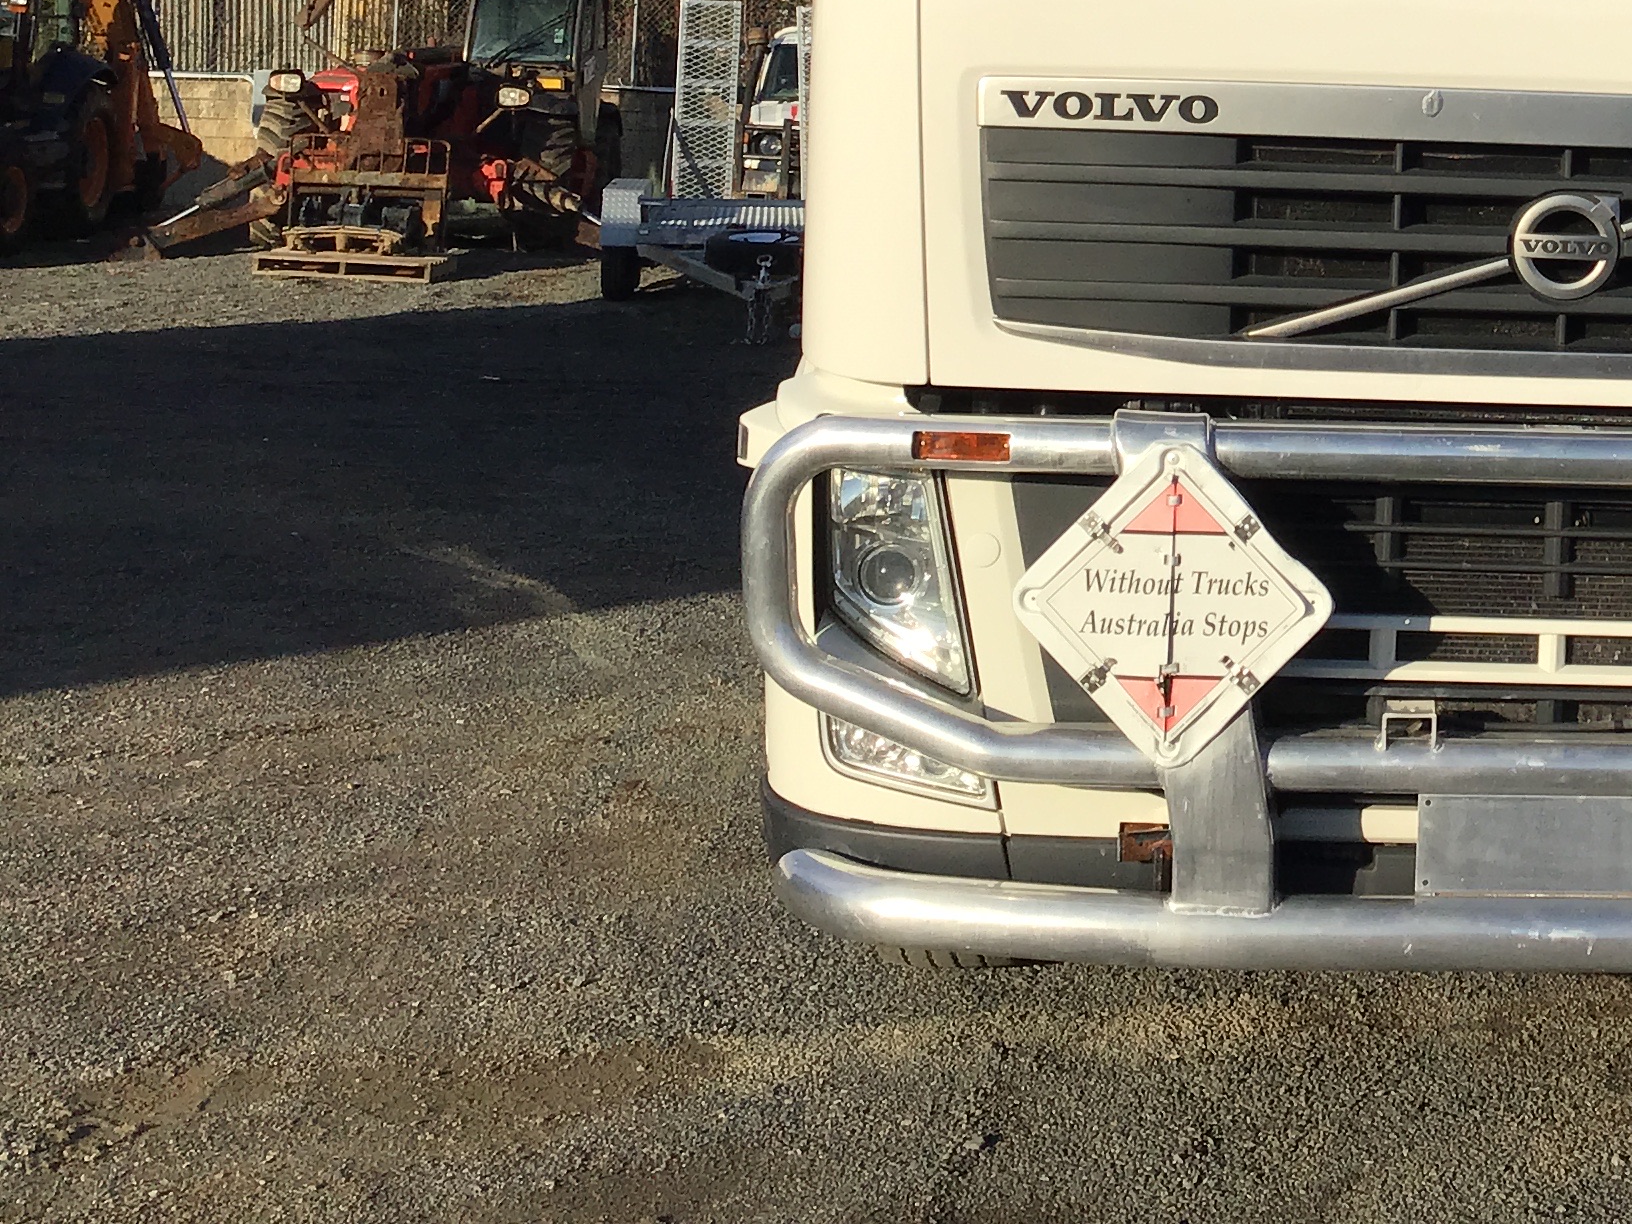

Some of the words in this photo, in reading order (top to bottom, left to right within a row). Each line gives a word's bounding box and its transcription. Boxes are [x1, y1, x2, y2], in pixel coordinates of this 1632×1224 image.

[1000, 89, 1220, 124] VOLVO
[1520, 239, 1614, 256] VOLVO
[1084, 568, 1184, 597] Without
[1192, 571, 1270, 598] Trucks
[1079, 610, 1196, 638] Australia
[1202, 612, 1269, 645] Stops
